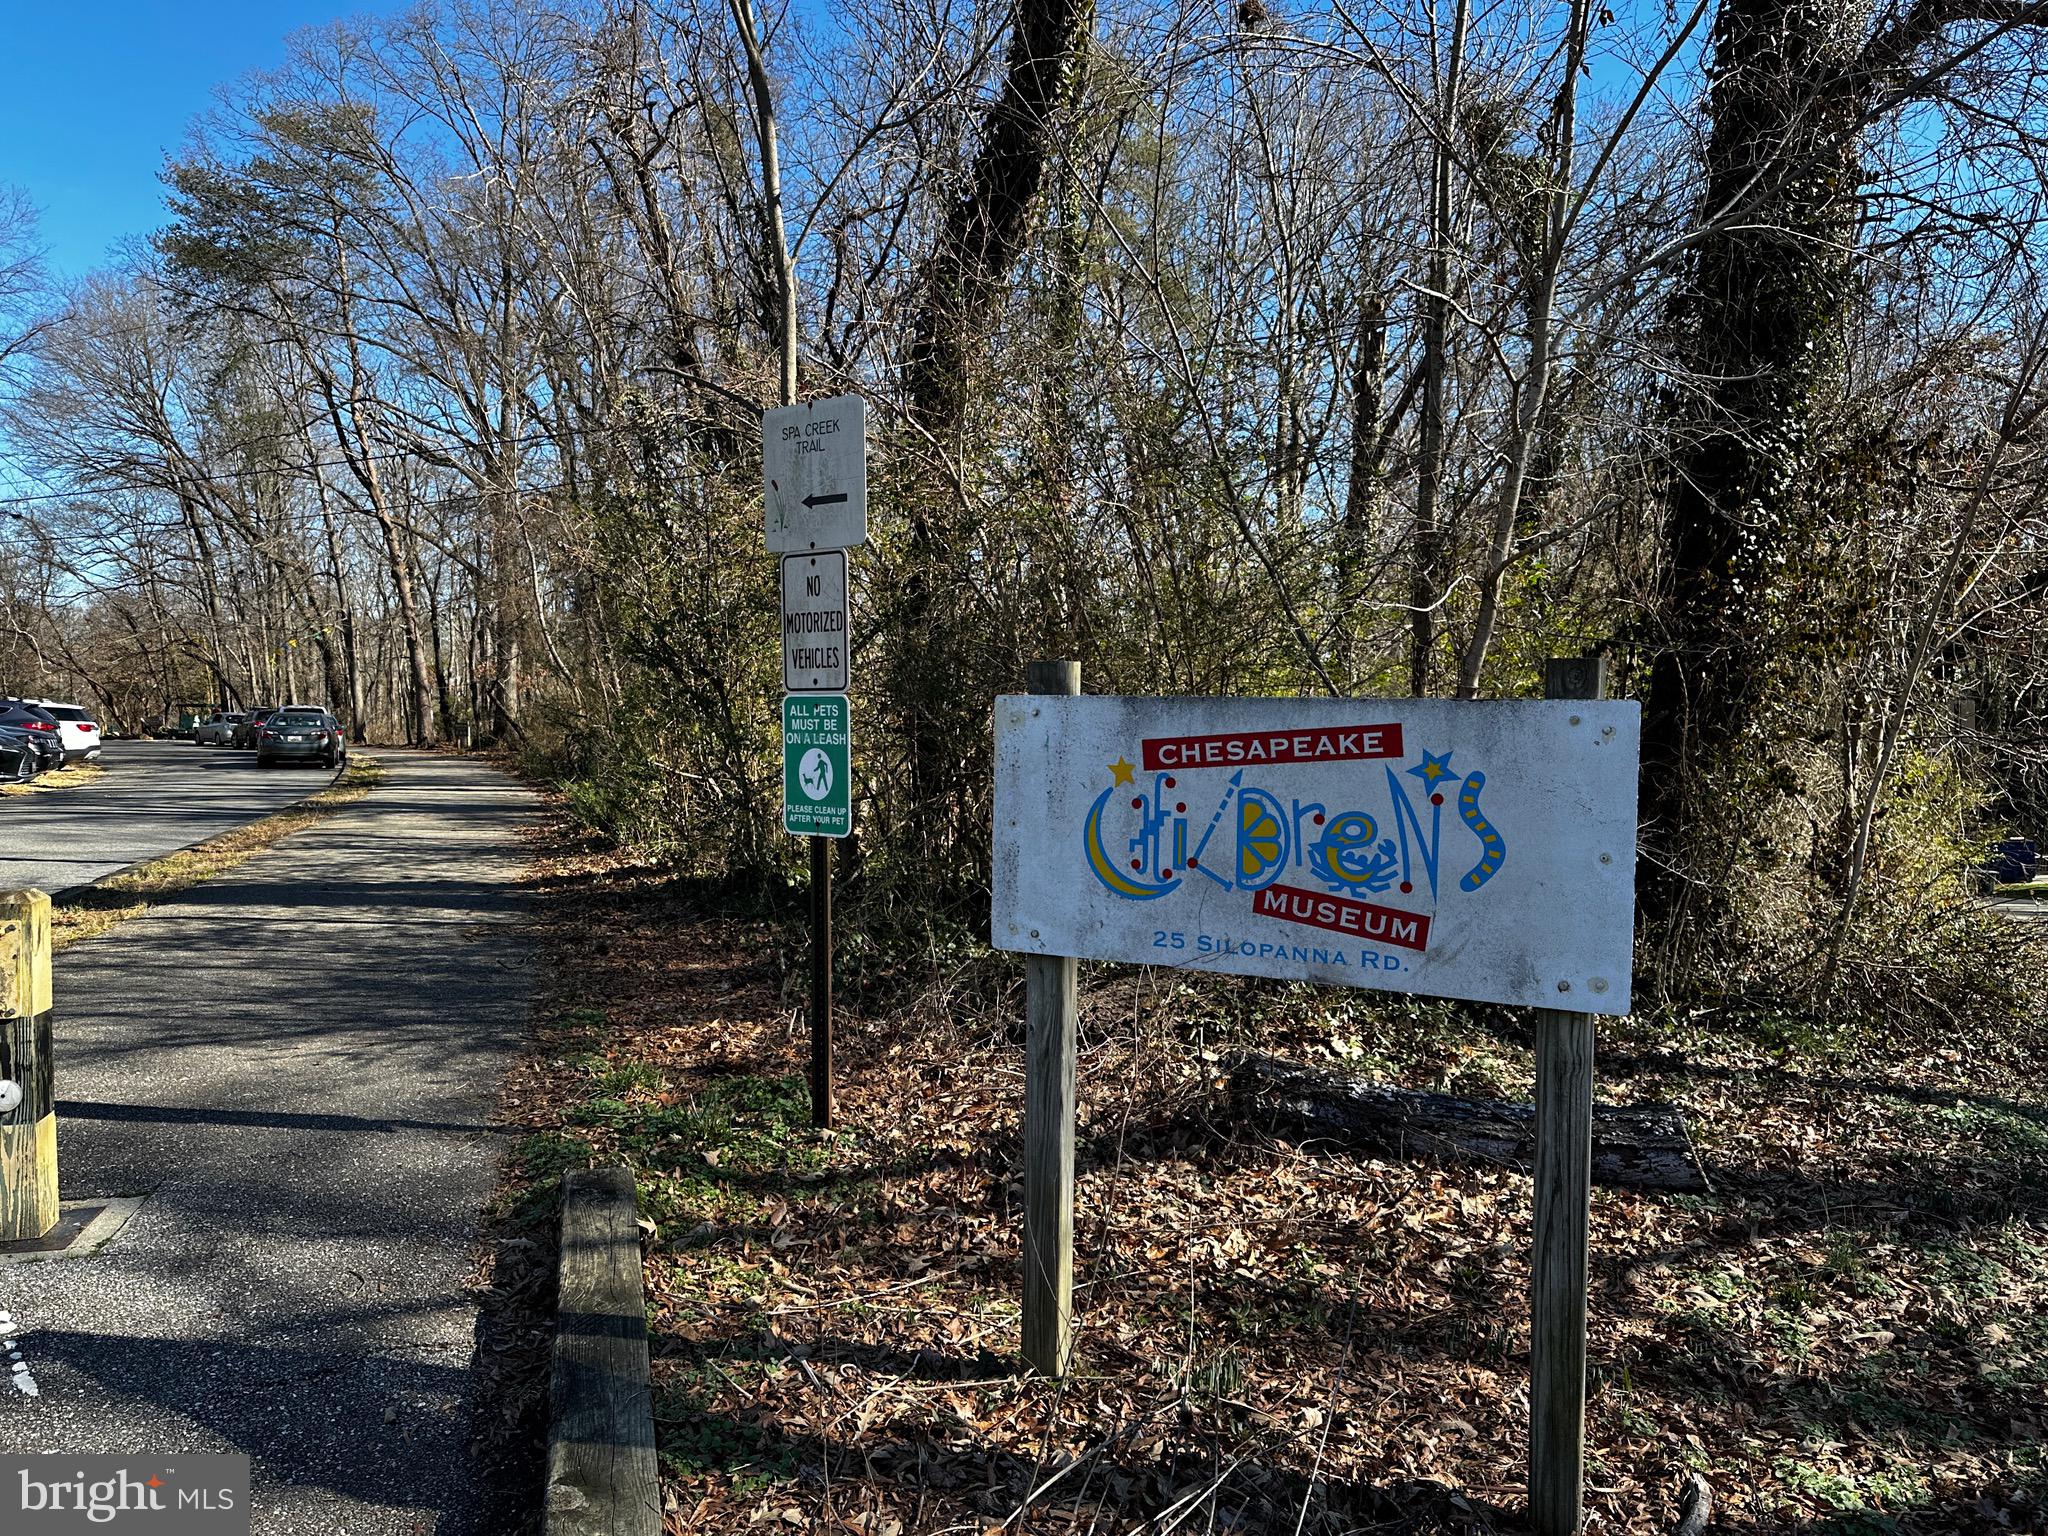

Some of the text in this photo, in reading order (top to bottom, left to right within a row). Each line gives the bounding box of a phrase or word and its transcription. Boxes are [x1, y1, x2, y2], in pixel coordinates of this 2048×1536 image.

[782, 419, 840, 441] SPA CREEK
[796, 438, 826, 455] TRAIL
[806, 575, 821, 597] NO
[786, 610, 843, 634] MOTORIZED
[792, 646, 840, 669] VEHICLES
[790, 704, 839, 716] ALL PETS
[791, 719, 838, 731] MUST BE
[786, 732, 846, 745] ON A LEASH
[1158, 731, 1384, 765] CHESAPEAKE
[787, 804, 847, 815] PLEASE CLEAN UP
[789, 814, 844, 825] AFTER YOUR PET
[1263, 889, 1418, 944] MUSEUM
[1152, 929, 1409, 973] 25 SILOPANNA RD.
